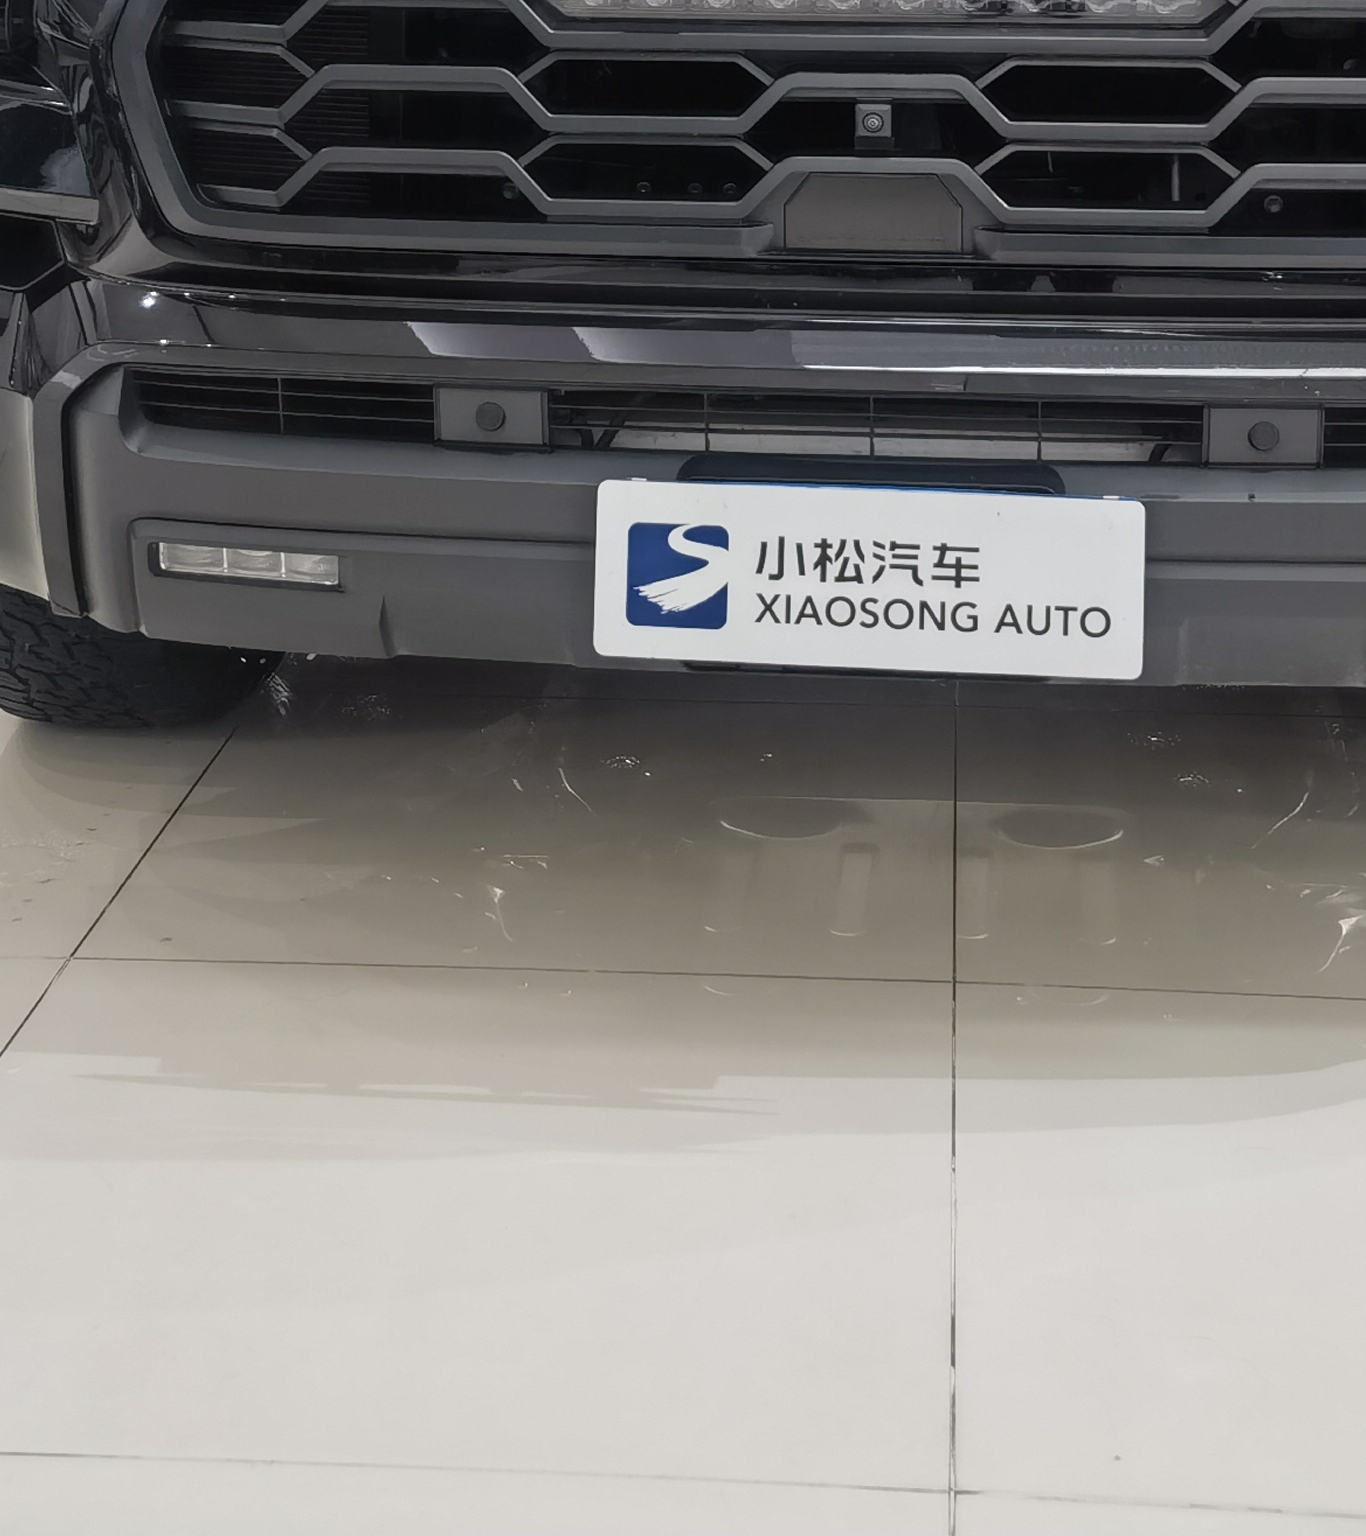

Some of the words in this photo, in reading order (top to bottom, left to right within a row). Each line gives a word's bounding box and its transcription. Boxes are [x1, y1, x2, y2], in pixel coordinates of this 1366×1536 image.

[755, 535, 981, 589] 小松汽车
[754, 592, 979, 633] XIAOSONG
[994, 604, 1112, 639] AUTO
